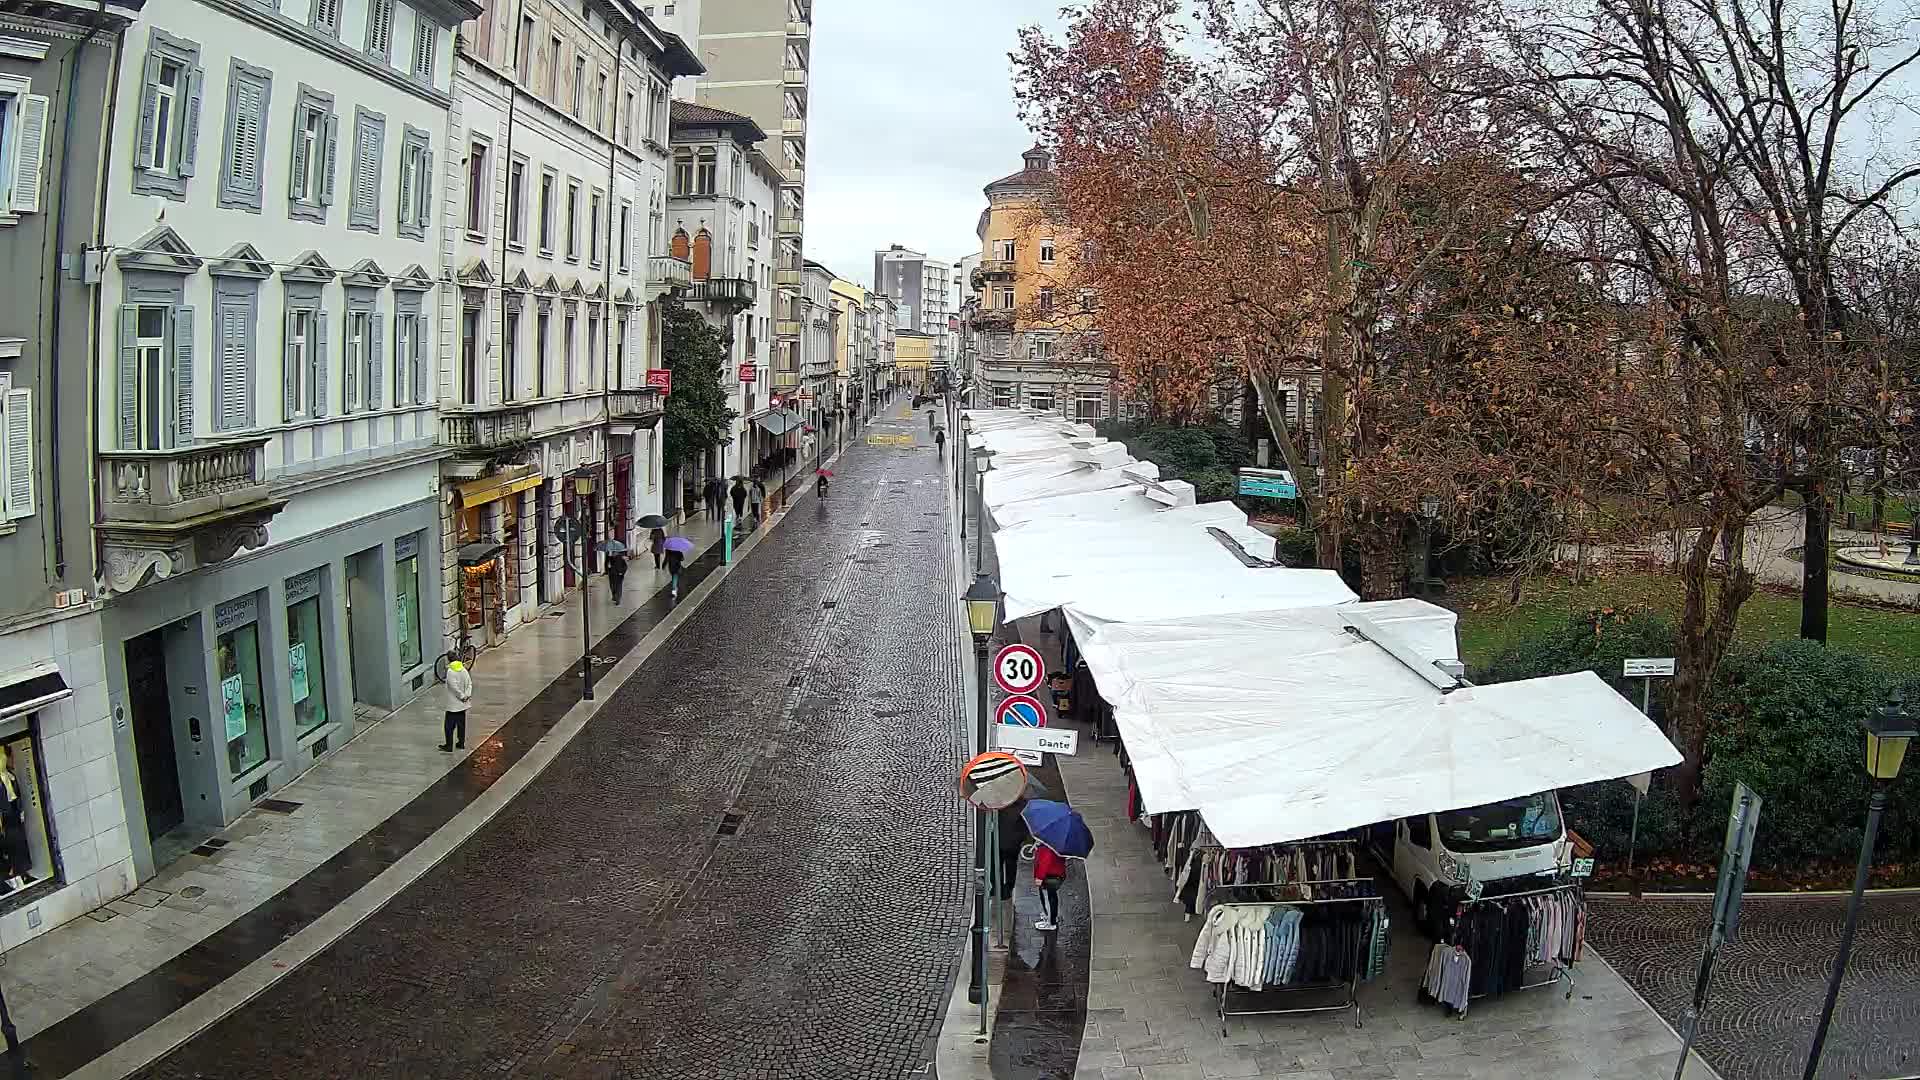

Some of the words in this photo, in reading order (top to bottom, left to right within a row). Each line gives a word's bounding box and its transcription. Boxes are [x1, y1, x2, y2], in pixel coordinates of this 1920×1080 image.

[1006, 659, 1033, 680] 30
[223, 678, 241, 698] 130
[1039, 738, 1070, 750] Dante
